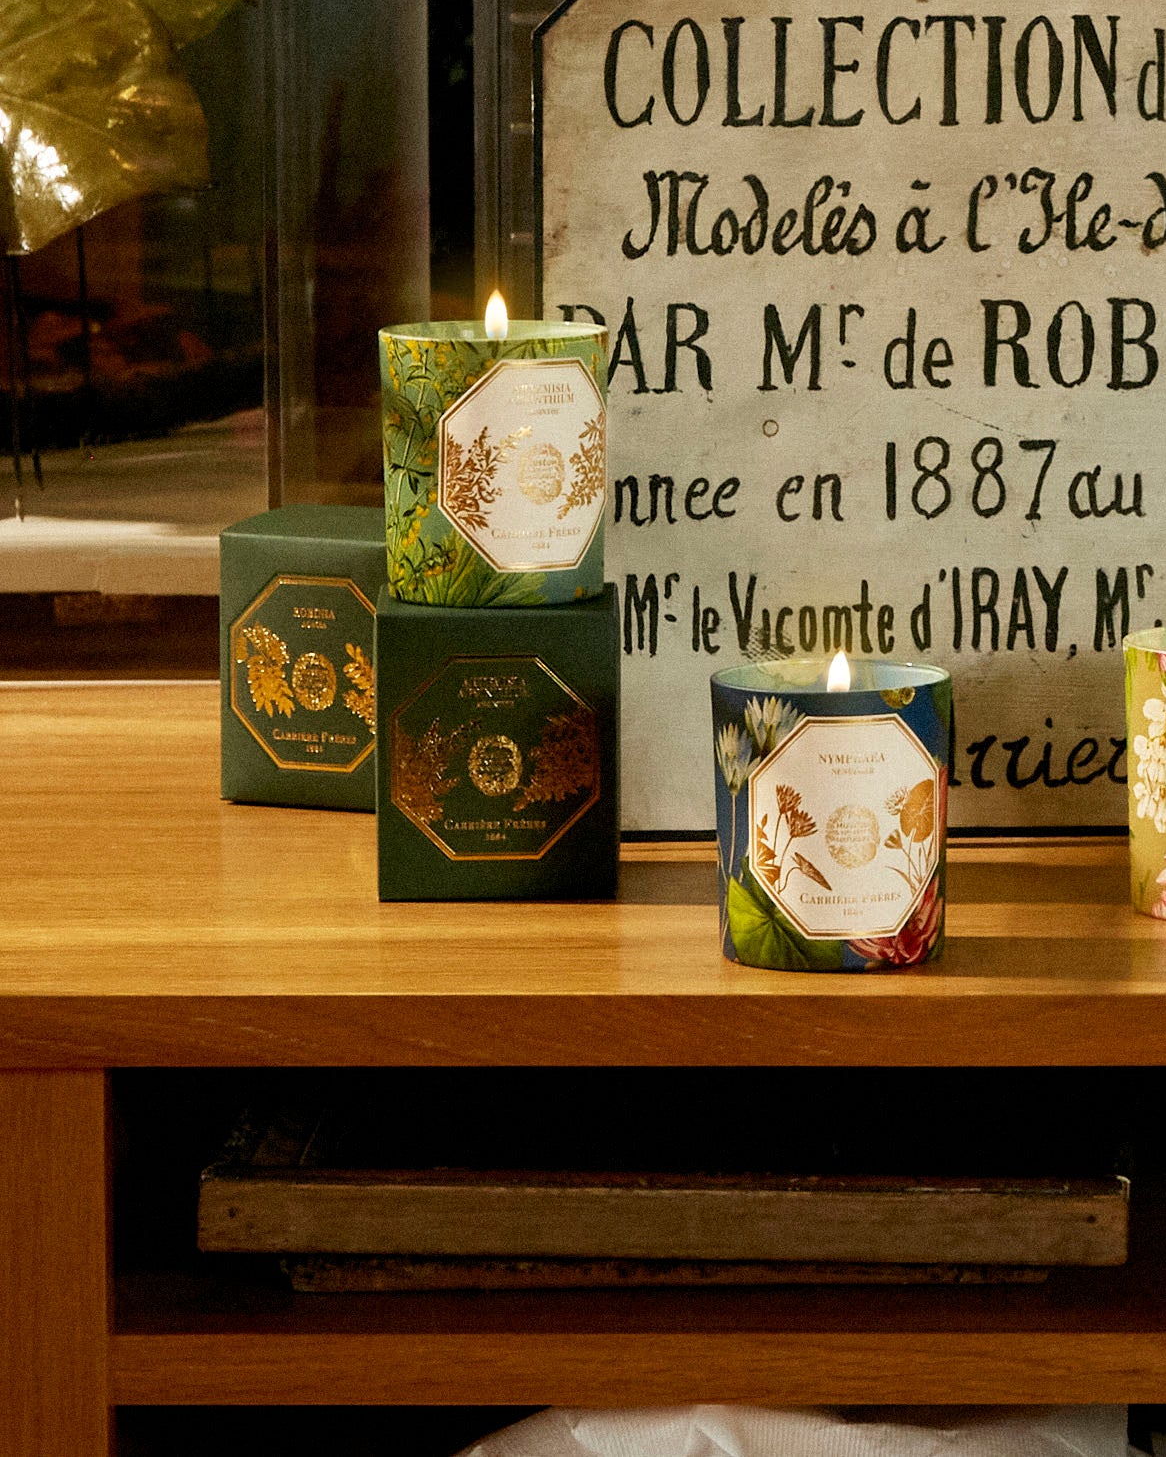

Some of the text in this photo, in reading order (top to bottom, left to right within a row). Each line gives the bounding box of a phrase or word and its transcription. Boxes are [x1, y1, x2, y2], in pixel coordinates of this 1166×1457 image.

[603, 14, 1121, 129] COLLECTION
[883, 307, 955, 390] de
[775, 473, 845, 523] en
[885, 435, 1058, 521] 1887
[1067, 464, 1145, 520] au
[691, 585, 722, 655] le
[727, 570, 896, 655] Vicomte
